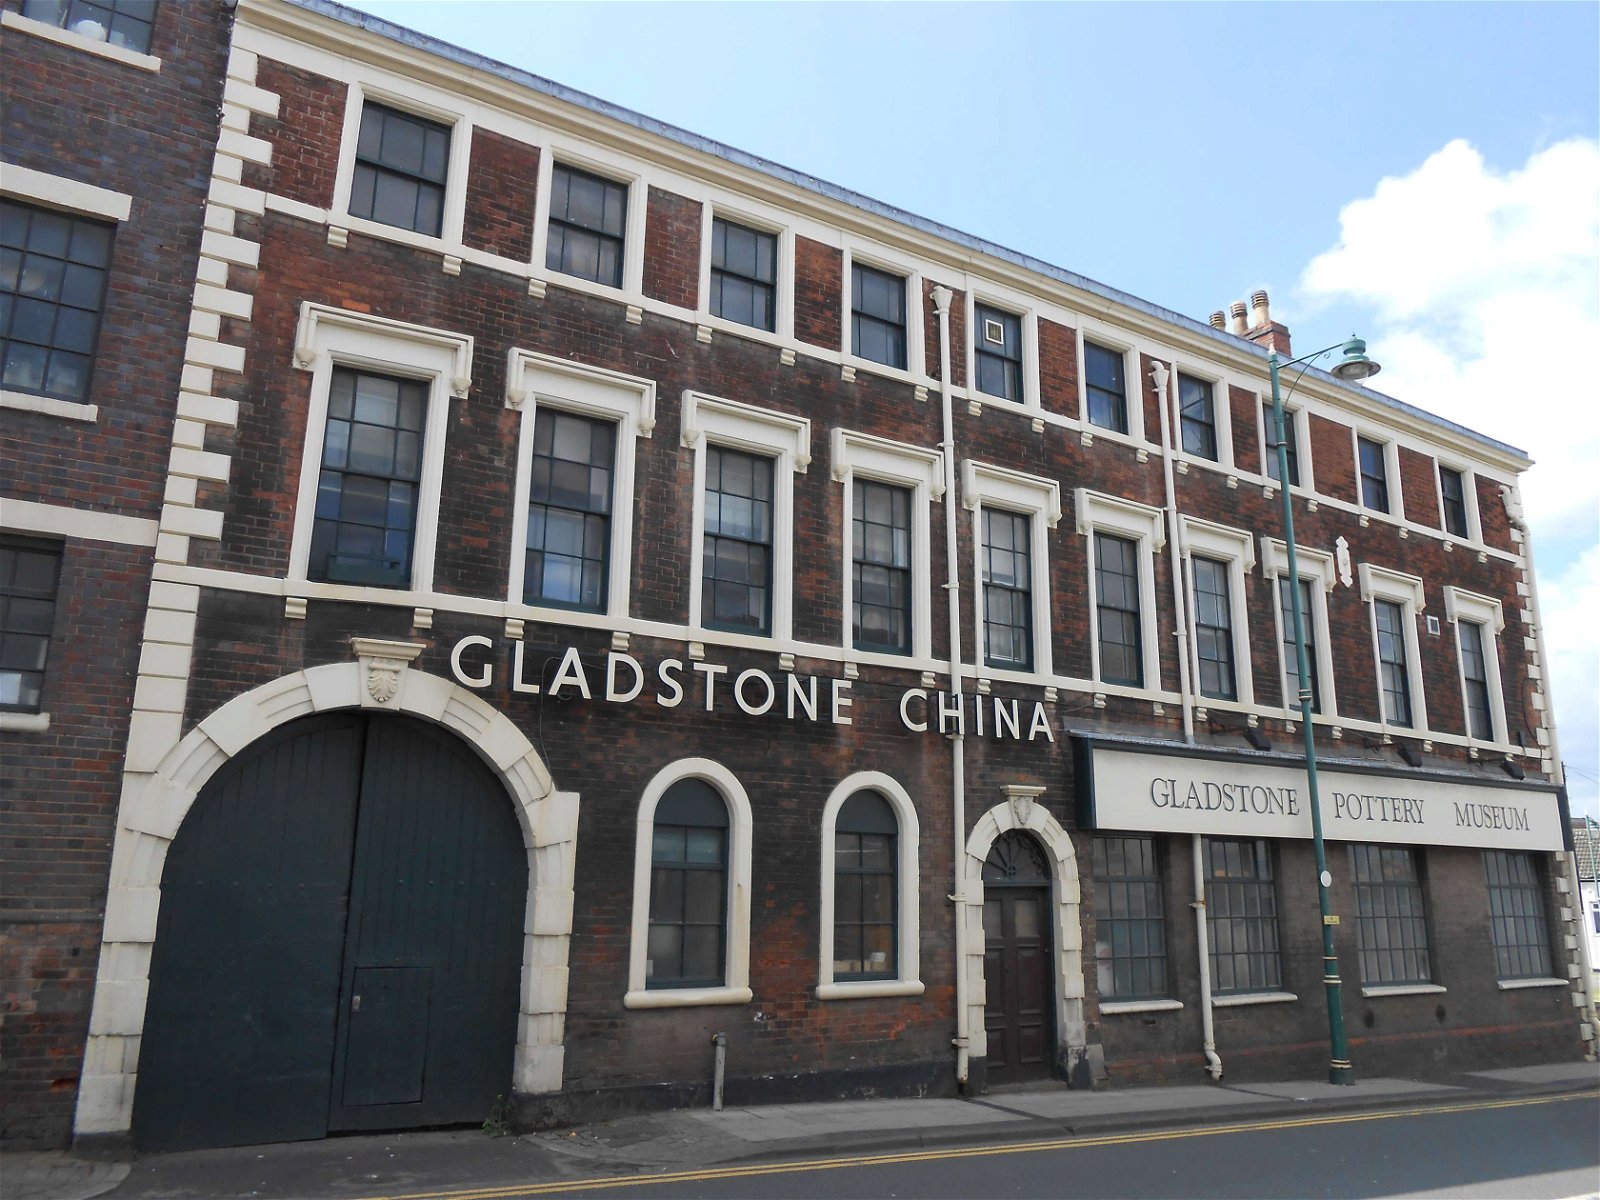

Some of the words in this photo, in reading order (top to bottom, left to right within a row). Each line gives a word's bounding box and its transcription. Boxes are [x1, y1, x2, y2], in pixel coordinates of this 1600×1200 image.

[450, 635, 853, 725] GLADSTONE
[899, 687, 1055, 742] CHINA
[1150, 777, 1300, 816] GLADSTONE
[1333, 792, 1424, 824] POTTERY
[1453, 802, 1530, 831] MUSEUM
